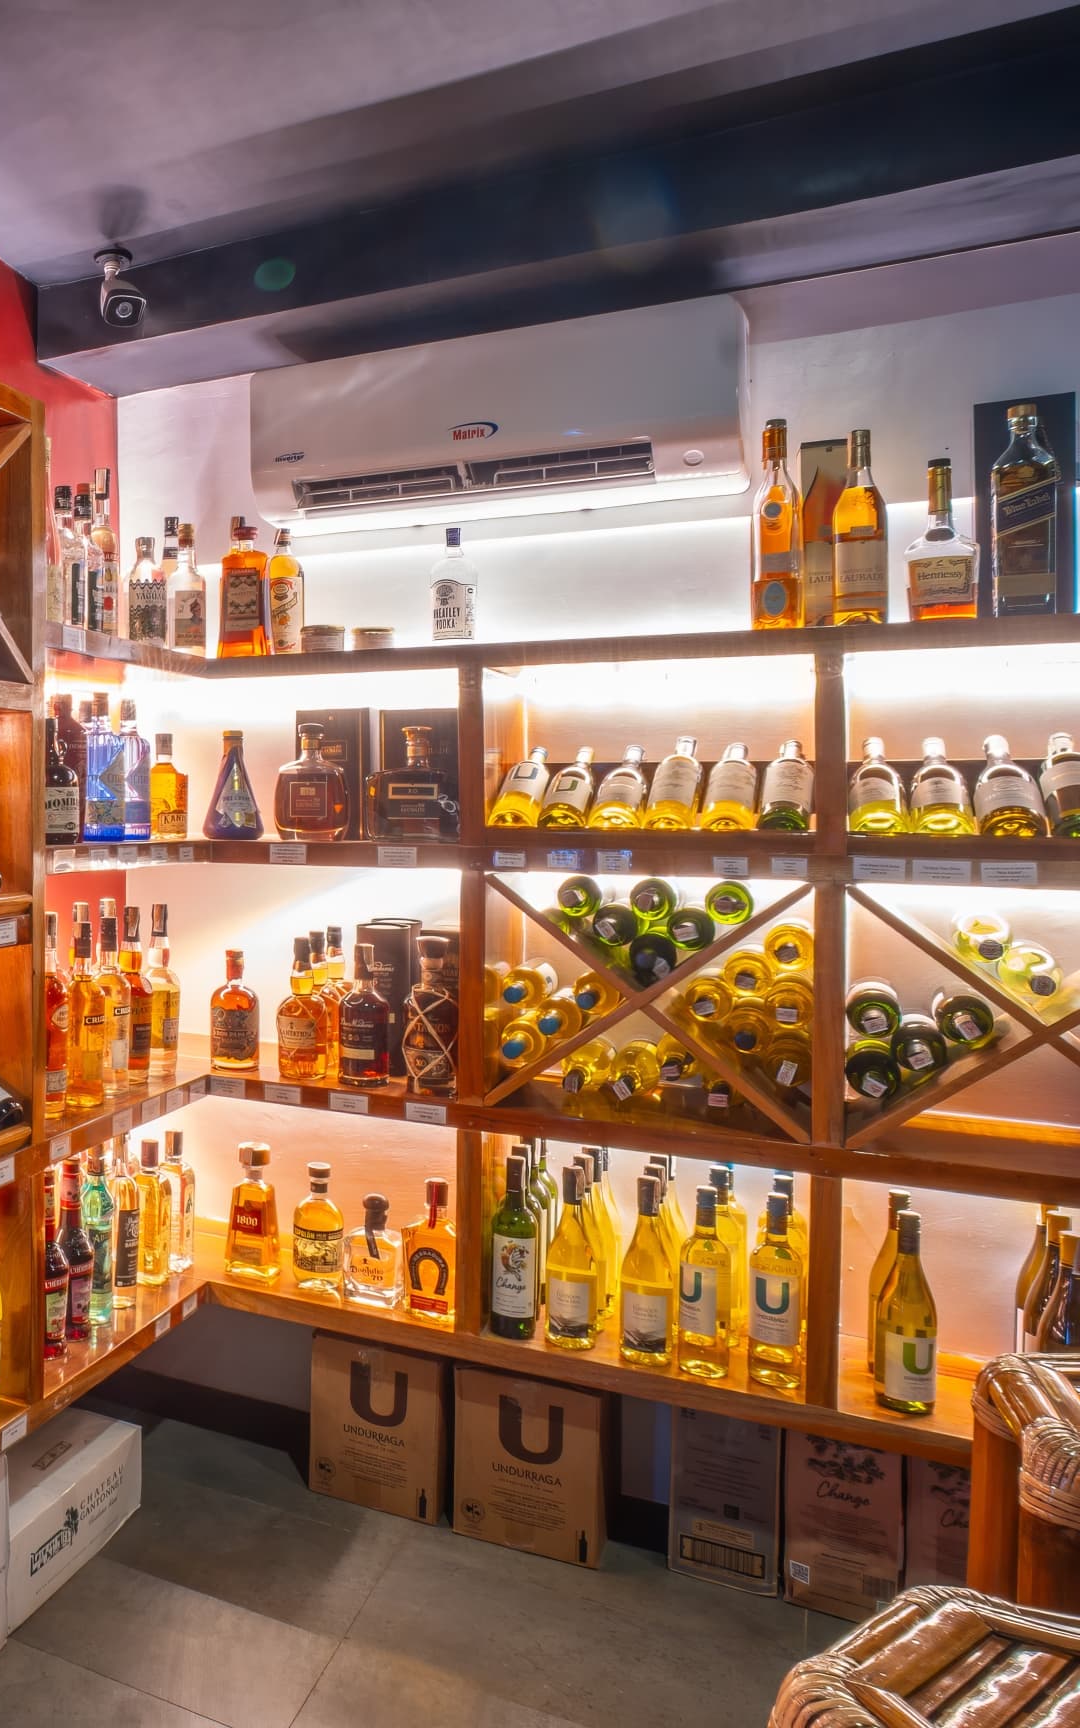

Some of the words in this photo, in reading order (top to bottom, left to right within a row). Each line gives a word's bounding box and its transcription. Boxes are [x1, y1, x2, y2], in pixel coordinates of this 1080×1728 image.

[452, 426, 487, 441] Matrix
[918, 570, 963, 582] Hennessy
[236, 1214, 258, 1227] 1800
[756, 1277, 790, 1315] U
[902, 1341, 934, 1376] U
[349, 1360, 409, 1427] U
[342, 1422, 406, 1449] UNDURRAGA
[498, 1393, 565, 1466] U
[80, 1464, 127, 1510] CHATEAU
[490, 1461, 563, 1488] UNDURRAGA
